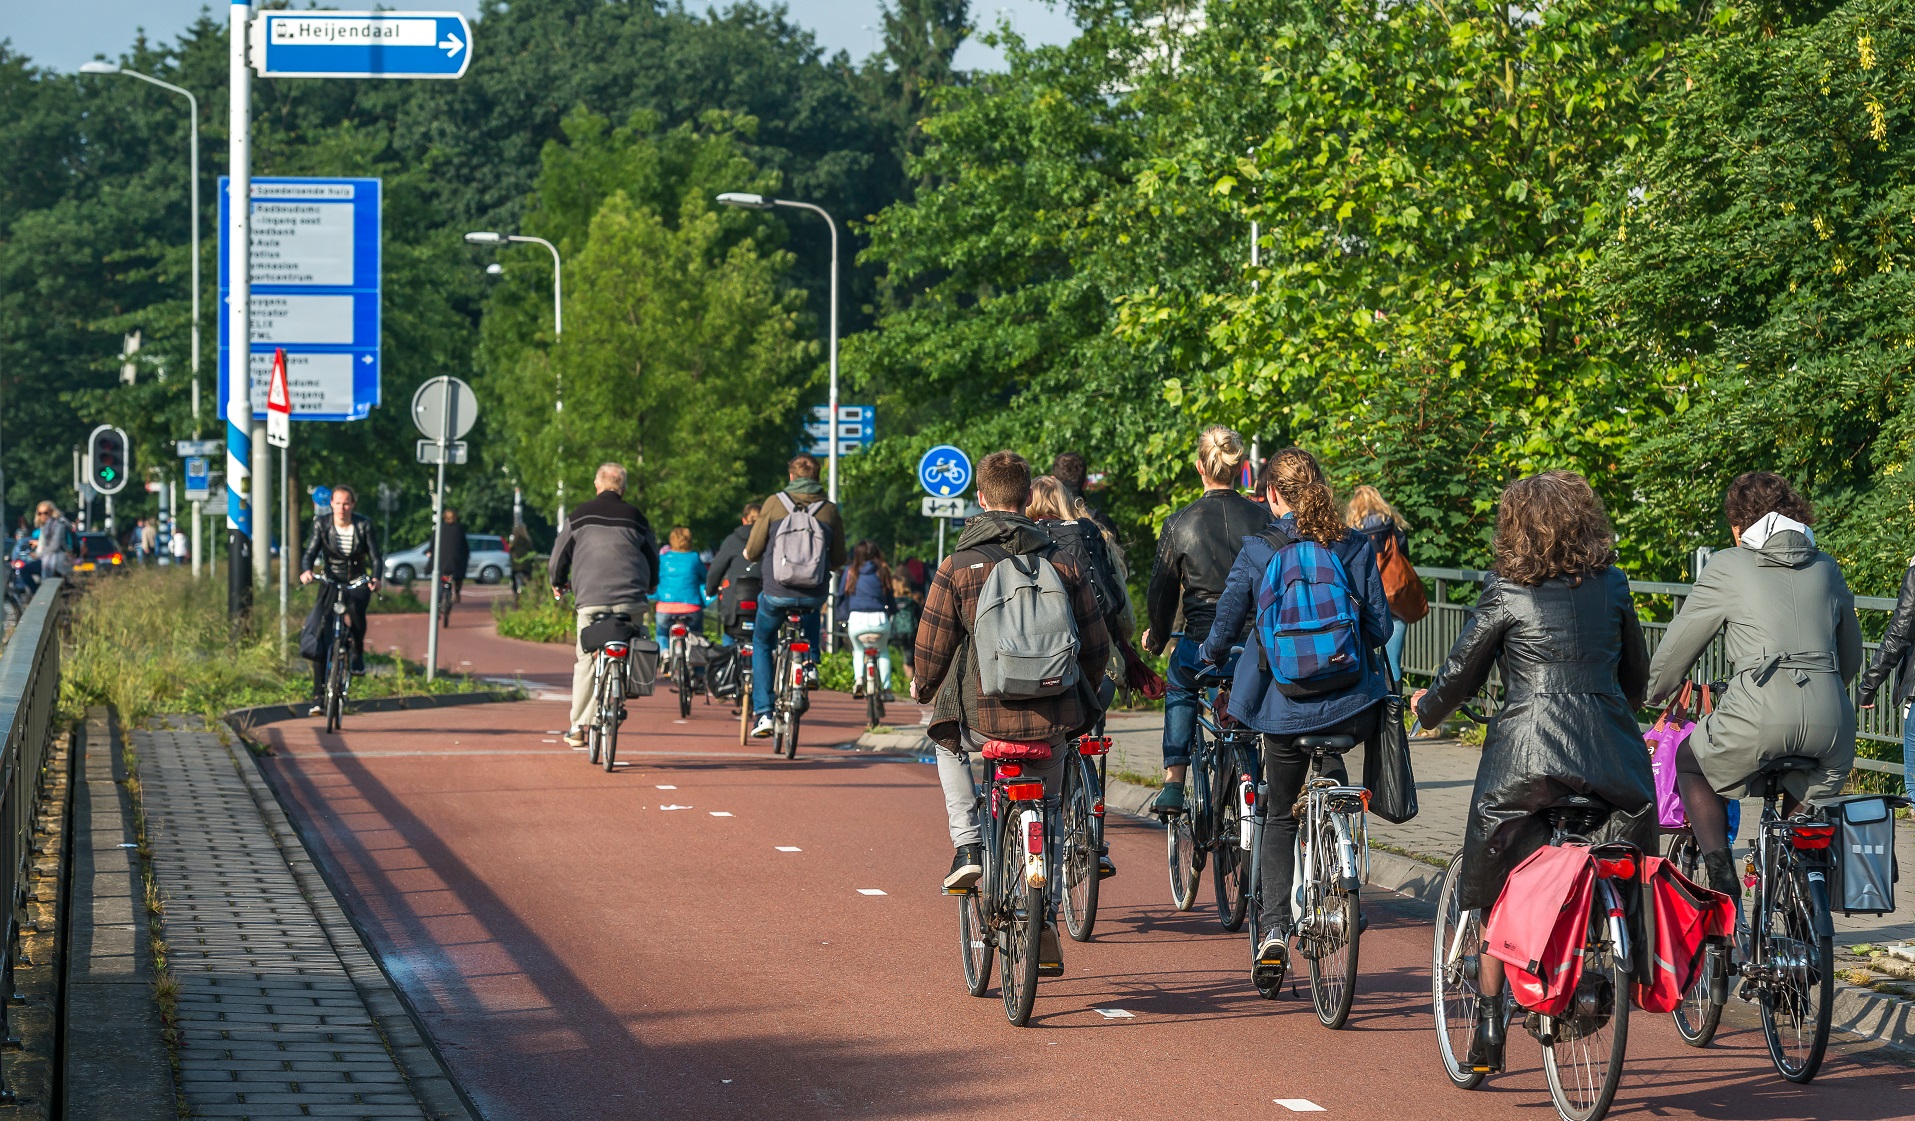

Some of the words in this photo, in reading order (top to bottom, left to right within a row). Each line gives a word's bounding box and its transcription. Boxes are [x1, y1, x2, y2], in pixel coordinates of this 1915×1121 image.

[300, 23, 400, 41] Heijendaal
[257, 204, 321, 213] Radboudumc
[252, 227, 296, 236] oedbank
[250, 262, 299, 272] ymnasion
[250, 298, 288, 308] uygens
[250, 309, 289, 317] ercator
